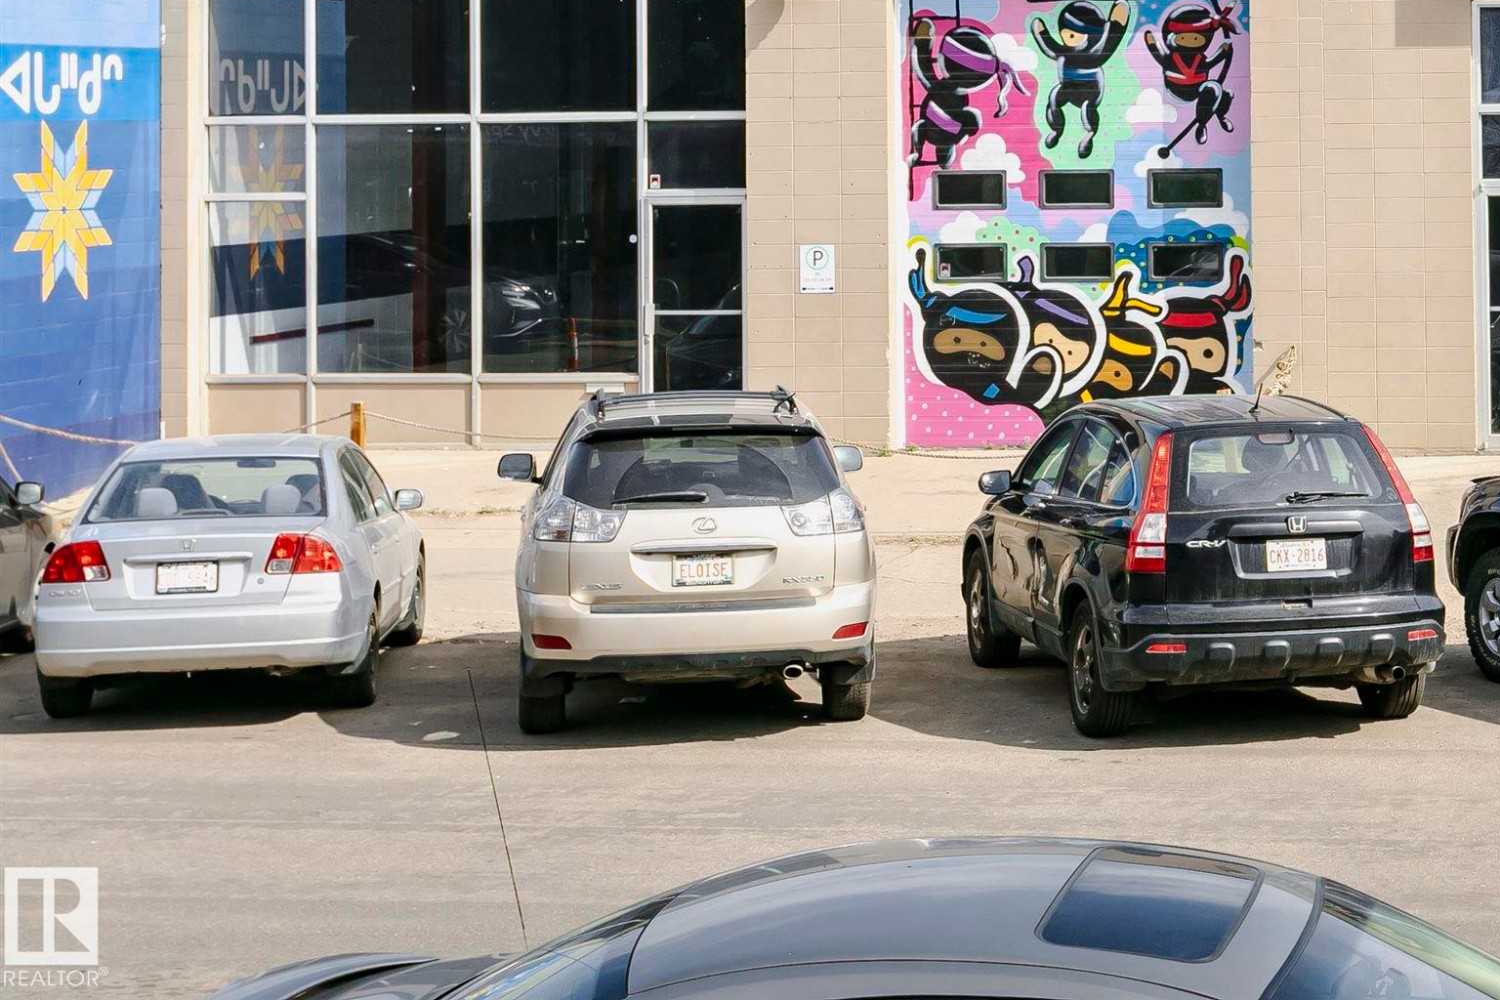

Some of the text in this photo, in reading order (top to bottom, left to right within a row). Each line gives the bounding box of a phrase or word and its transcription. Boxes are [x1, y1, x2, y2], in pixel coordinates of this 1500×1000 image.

[813, 250, 824, 267] P
[1185, 539, 1228, 548] CR-V
[679, 562, 728, 579] ELOISE
